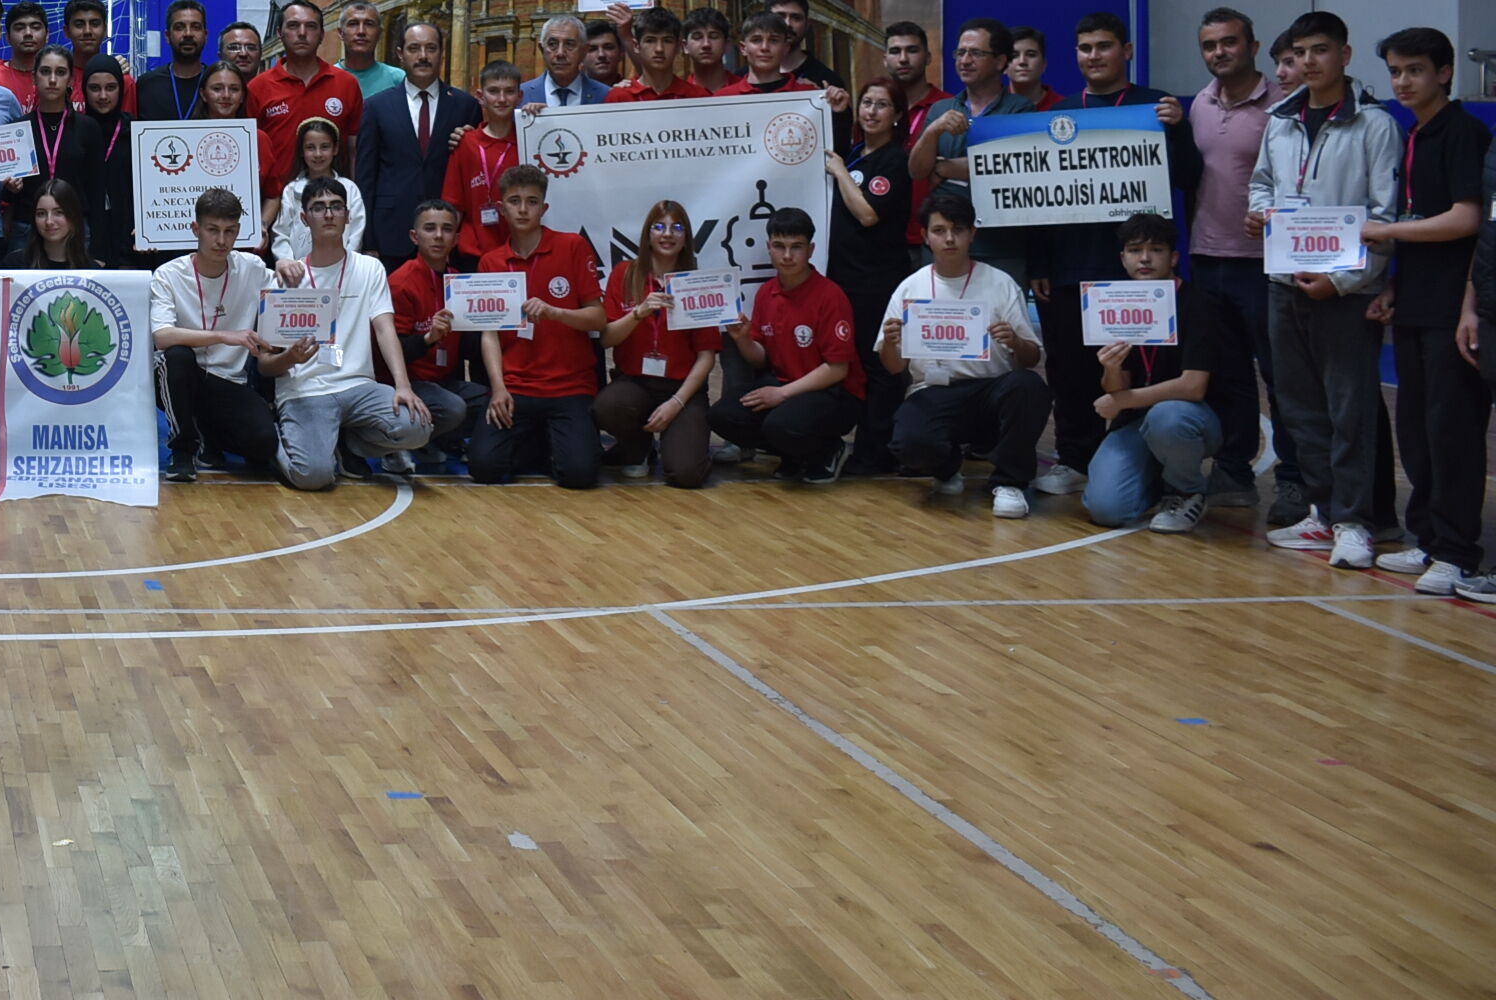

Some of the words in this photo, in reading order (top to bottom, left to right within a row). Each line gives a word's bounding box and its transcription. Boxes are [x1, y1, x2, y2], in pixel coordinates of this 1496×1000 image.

[596, 130, 654, 147] BURSA
[658, 122, 751, 143] ORHANELİ
[594, 153, 607, 163] A.
[610, 148, 659, 162] NECATİ
[662, 146, 716, 159] YILMAZ
[718, 144, 757, 156] MTAL
[974, 146, 1051, 175] ELEKTRİK
[1058, 139, 1162, 171] ELEKTRONİK
[159, 185, 187, 194] BURSA
[991, 178, 1096, 209] TEKNOLOJİSİ
[1099, 180, 1148, 205] ALANI
[146, 208, 192, 219] MESLEKİ
[9, 289, 37, 363] Şehzadeler
[36, 276, 75, 292] Gediz
[78, 277, 123, 318] Anadolu
[119, 319, 130, 362] Lisesi
